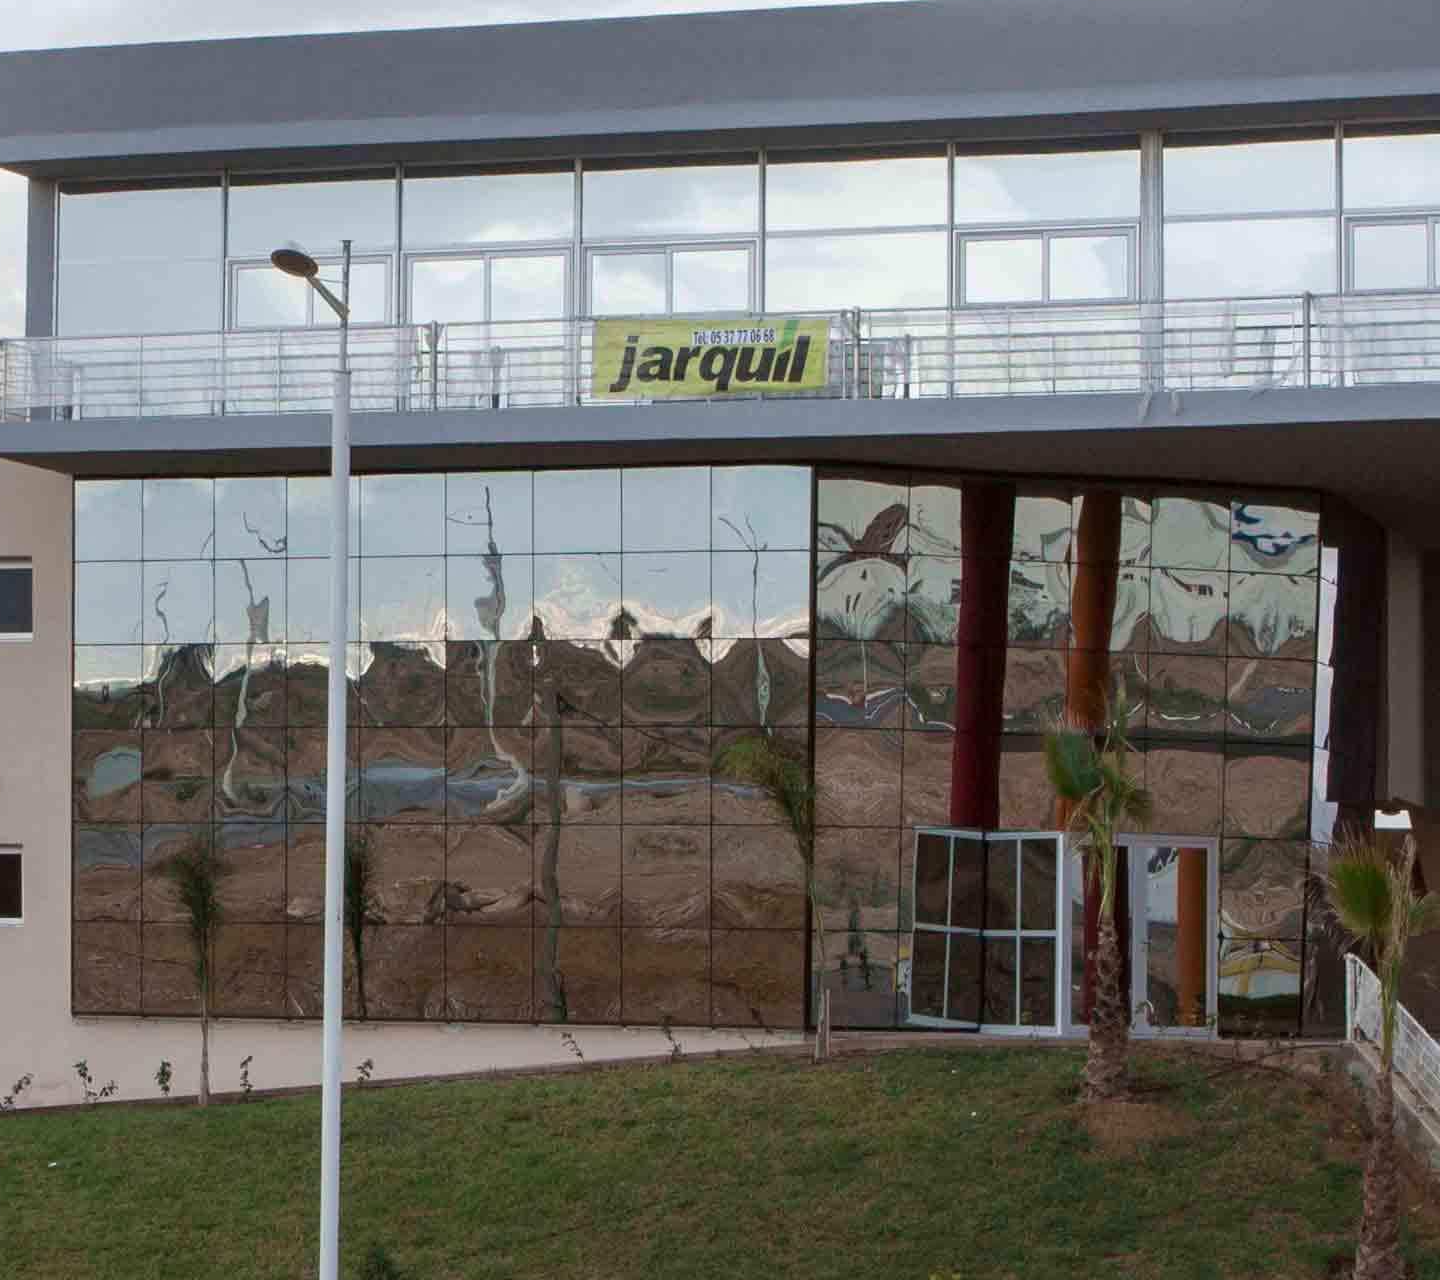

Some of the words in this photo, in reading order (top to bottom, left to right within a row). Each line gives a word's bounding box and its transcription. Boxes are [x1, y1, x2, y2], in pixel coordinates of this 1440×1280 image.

[710, 331, 721, 344] 05
[737, 330, 748, 343] 77
[751, 328, 760, 342] 06
[763, 328, 775, 342] 68
[609, 334, 810, 392] jarquil
